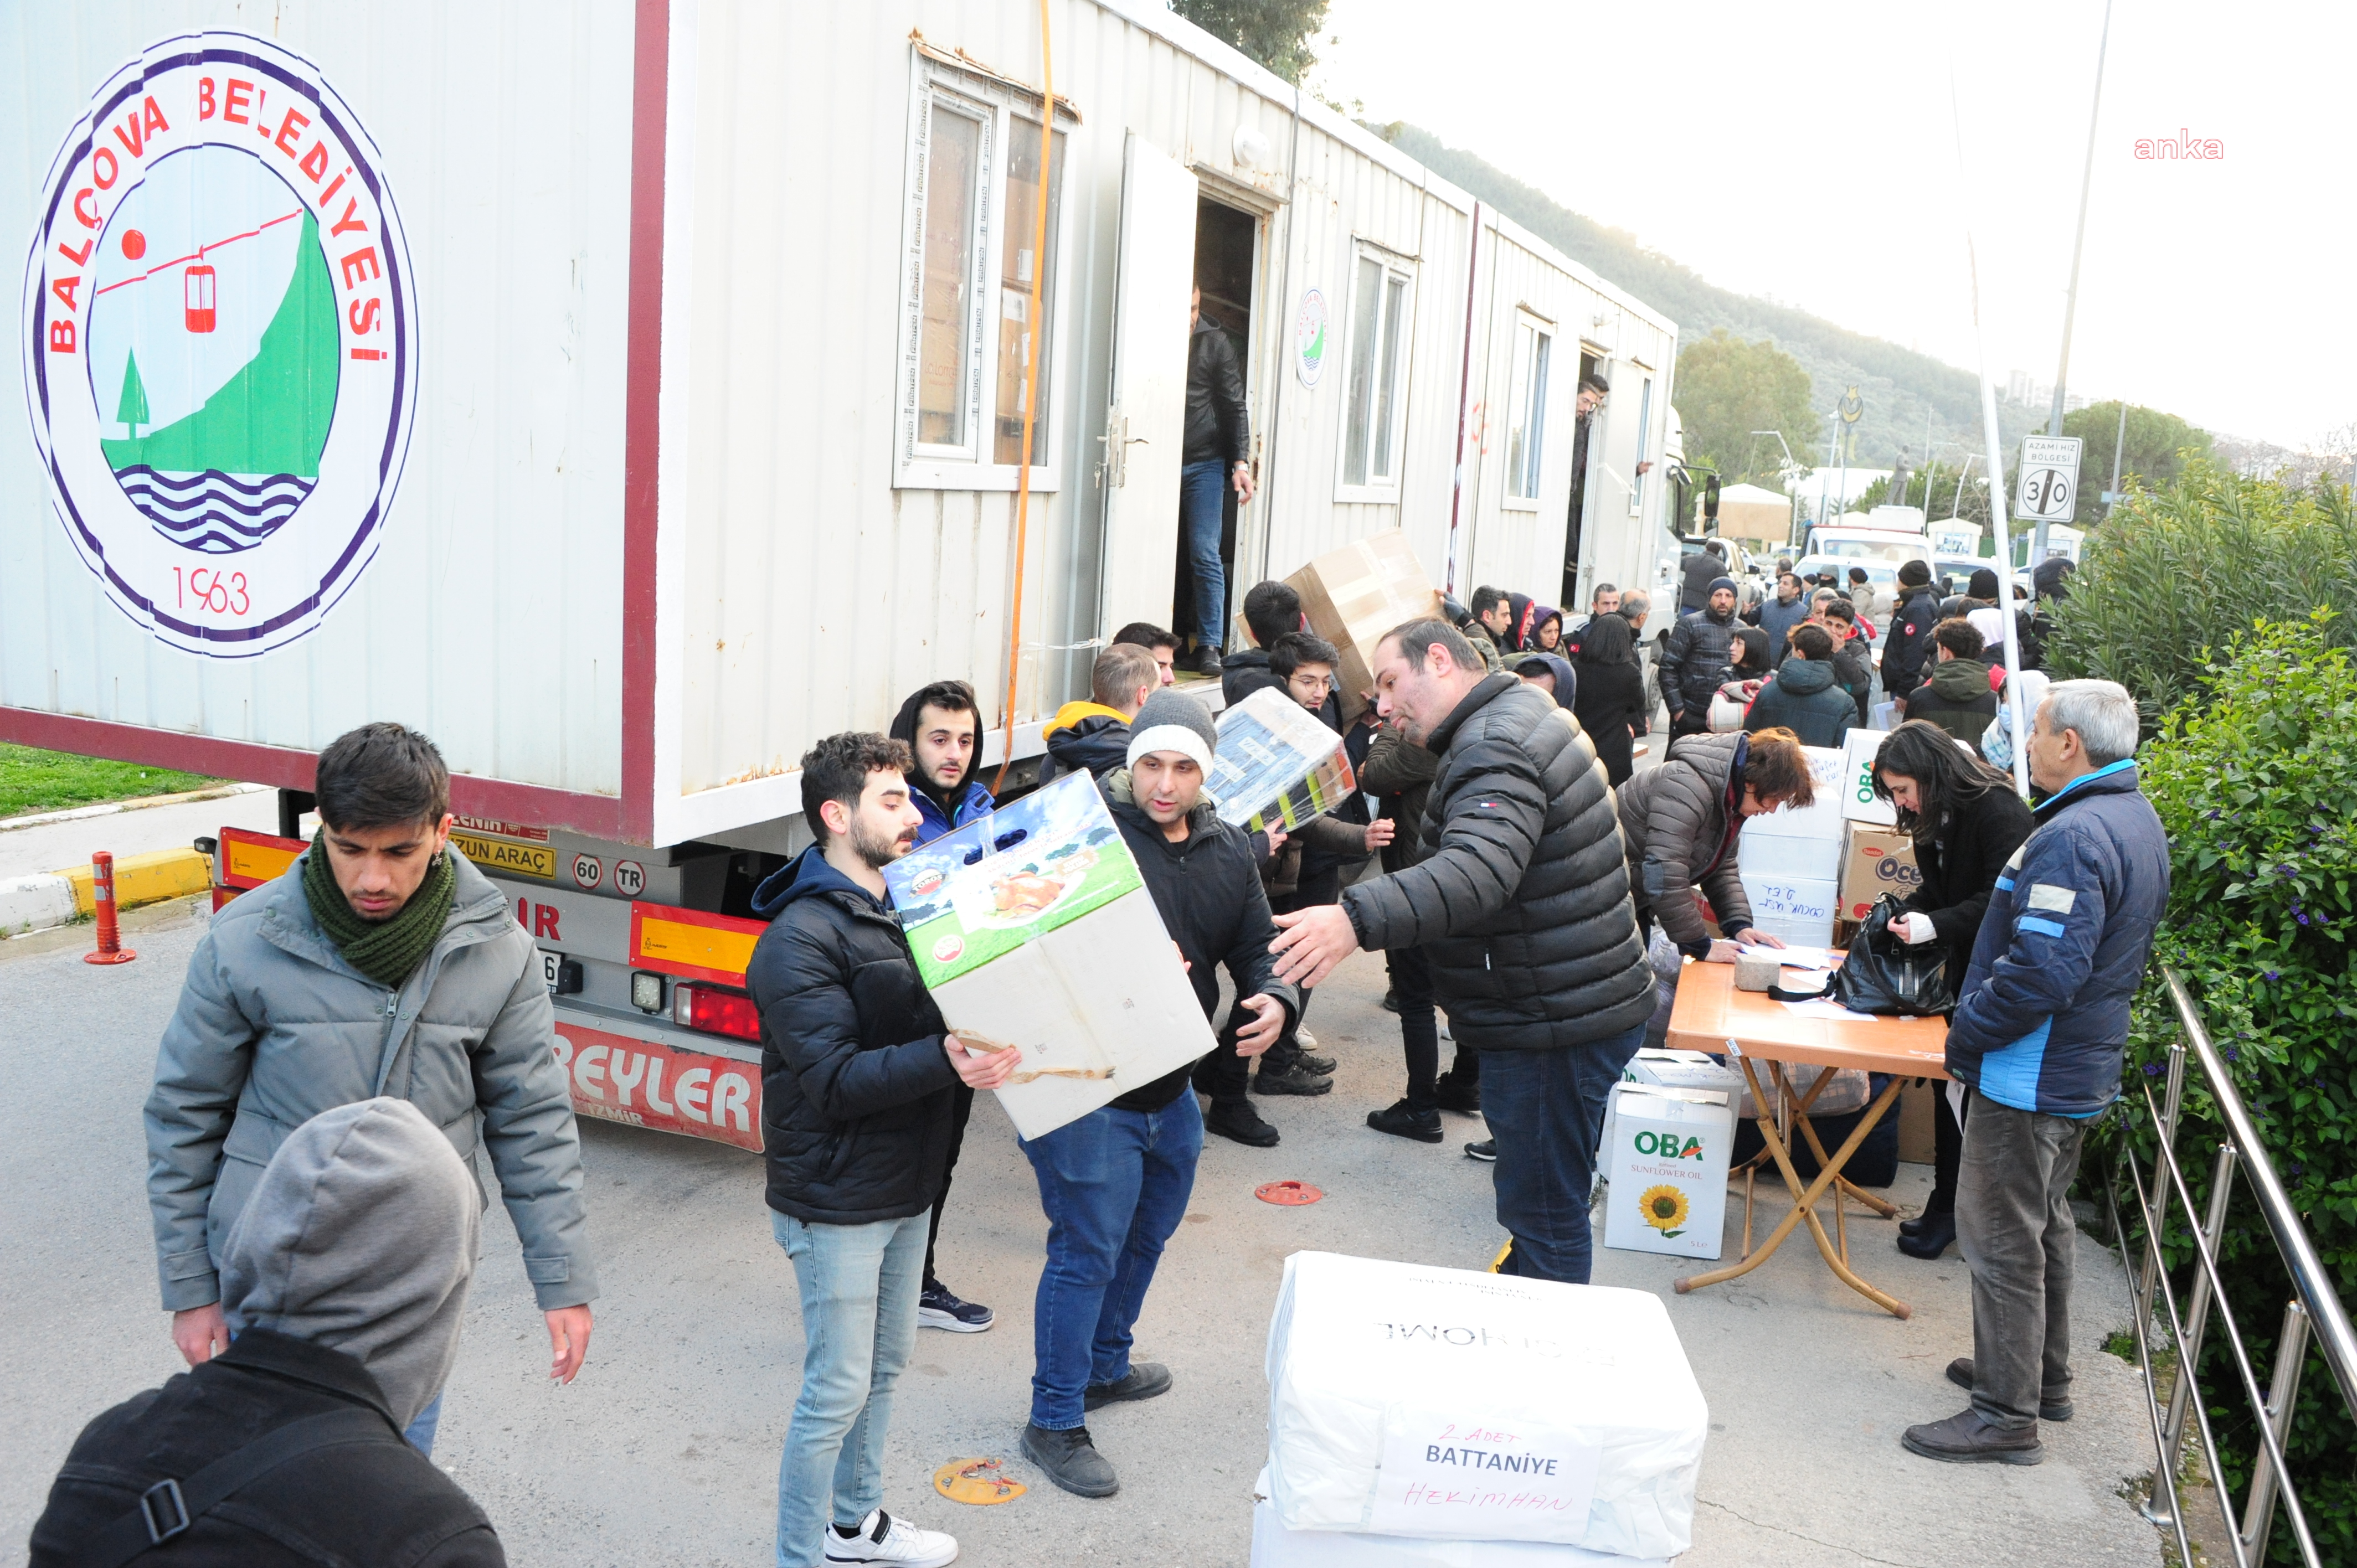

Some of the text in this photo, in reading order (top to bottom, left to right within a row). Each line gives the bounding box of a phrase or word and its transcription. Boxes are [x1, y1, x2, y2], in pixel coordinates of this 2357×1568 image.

[50, 77, 387, 361] BALÇOVA BELEDİYESİ
[2031, 452, 2071, 462] BÖLGESİ
[172, 566, 250, 615] 1963
[451, 838, 545, 872] ZUN ARAÇ
[577, 862, 598, 880] 60
[619, 869, 640, 888] TR
[913, 874, 943, 891] TOROS
[1635, 1131, 1703, 1160] OBA
[1631, 1164, 1685, 1178] SUNFLOWER
[1438, 1425, 1522, 1443] 2 ADET
[1426, 1445, 1558, 1476] BATTANİYE
